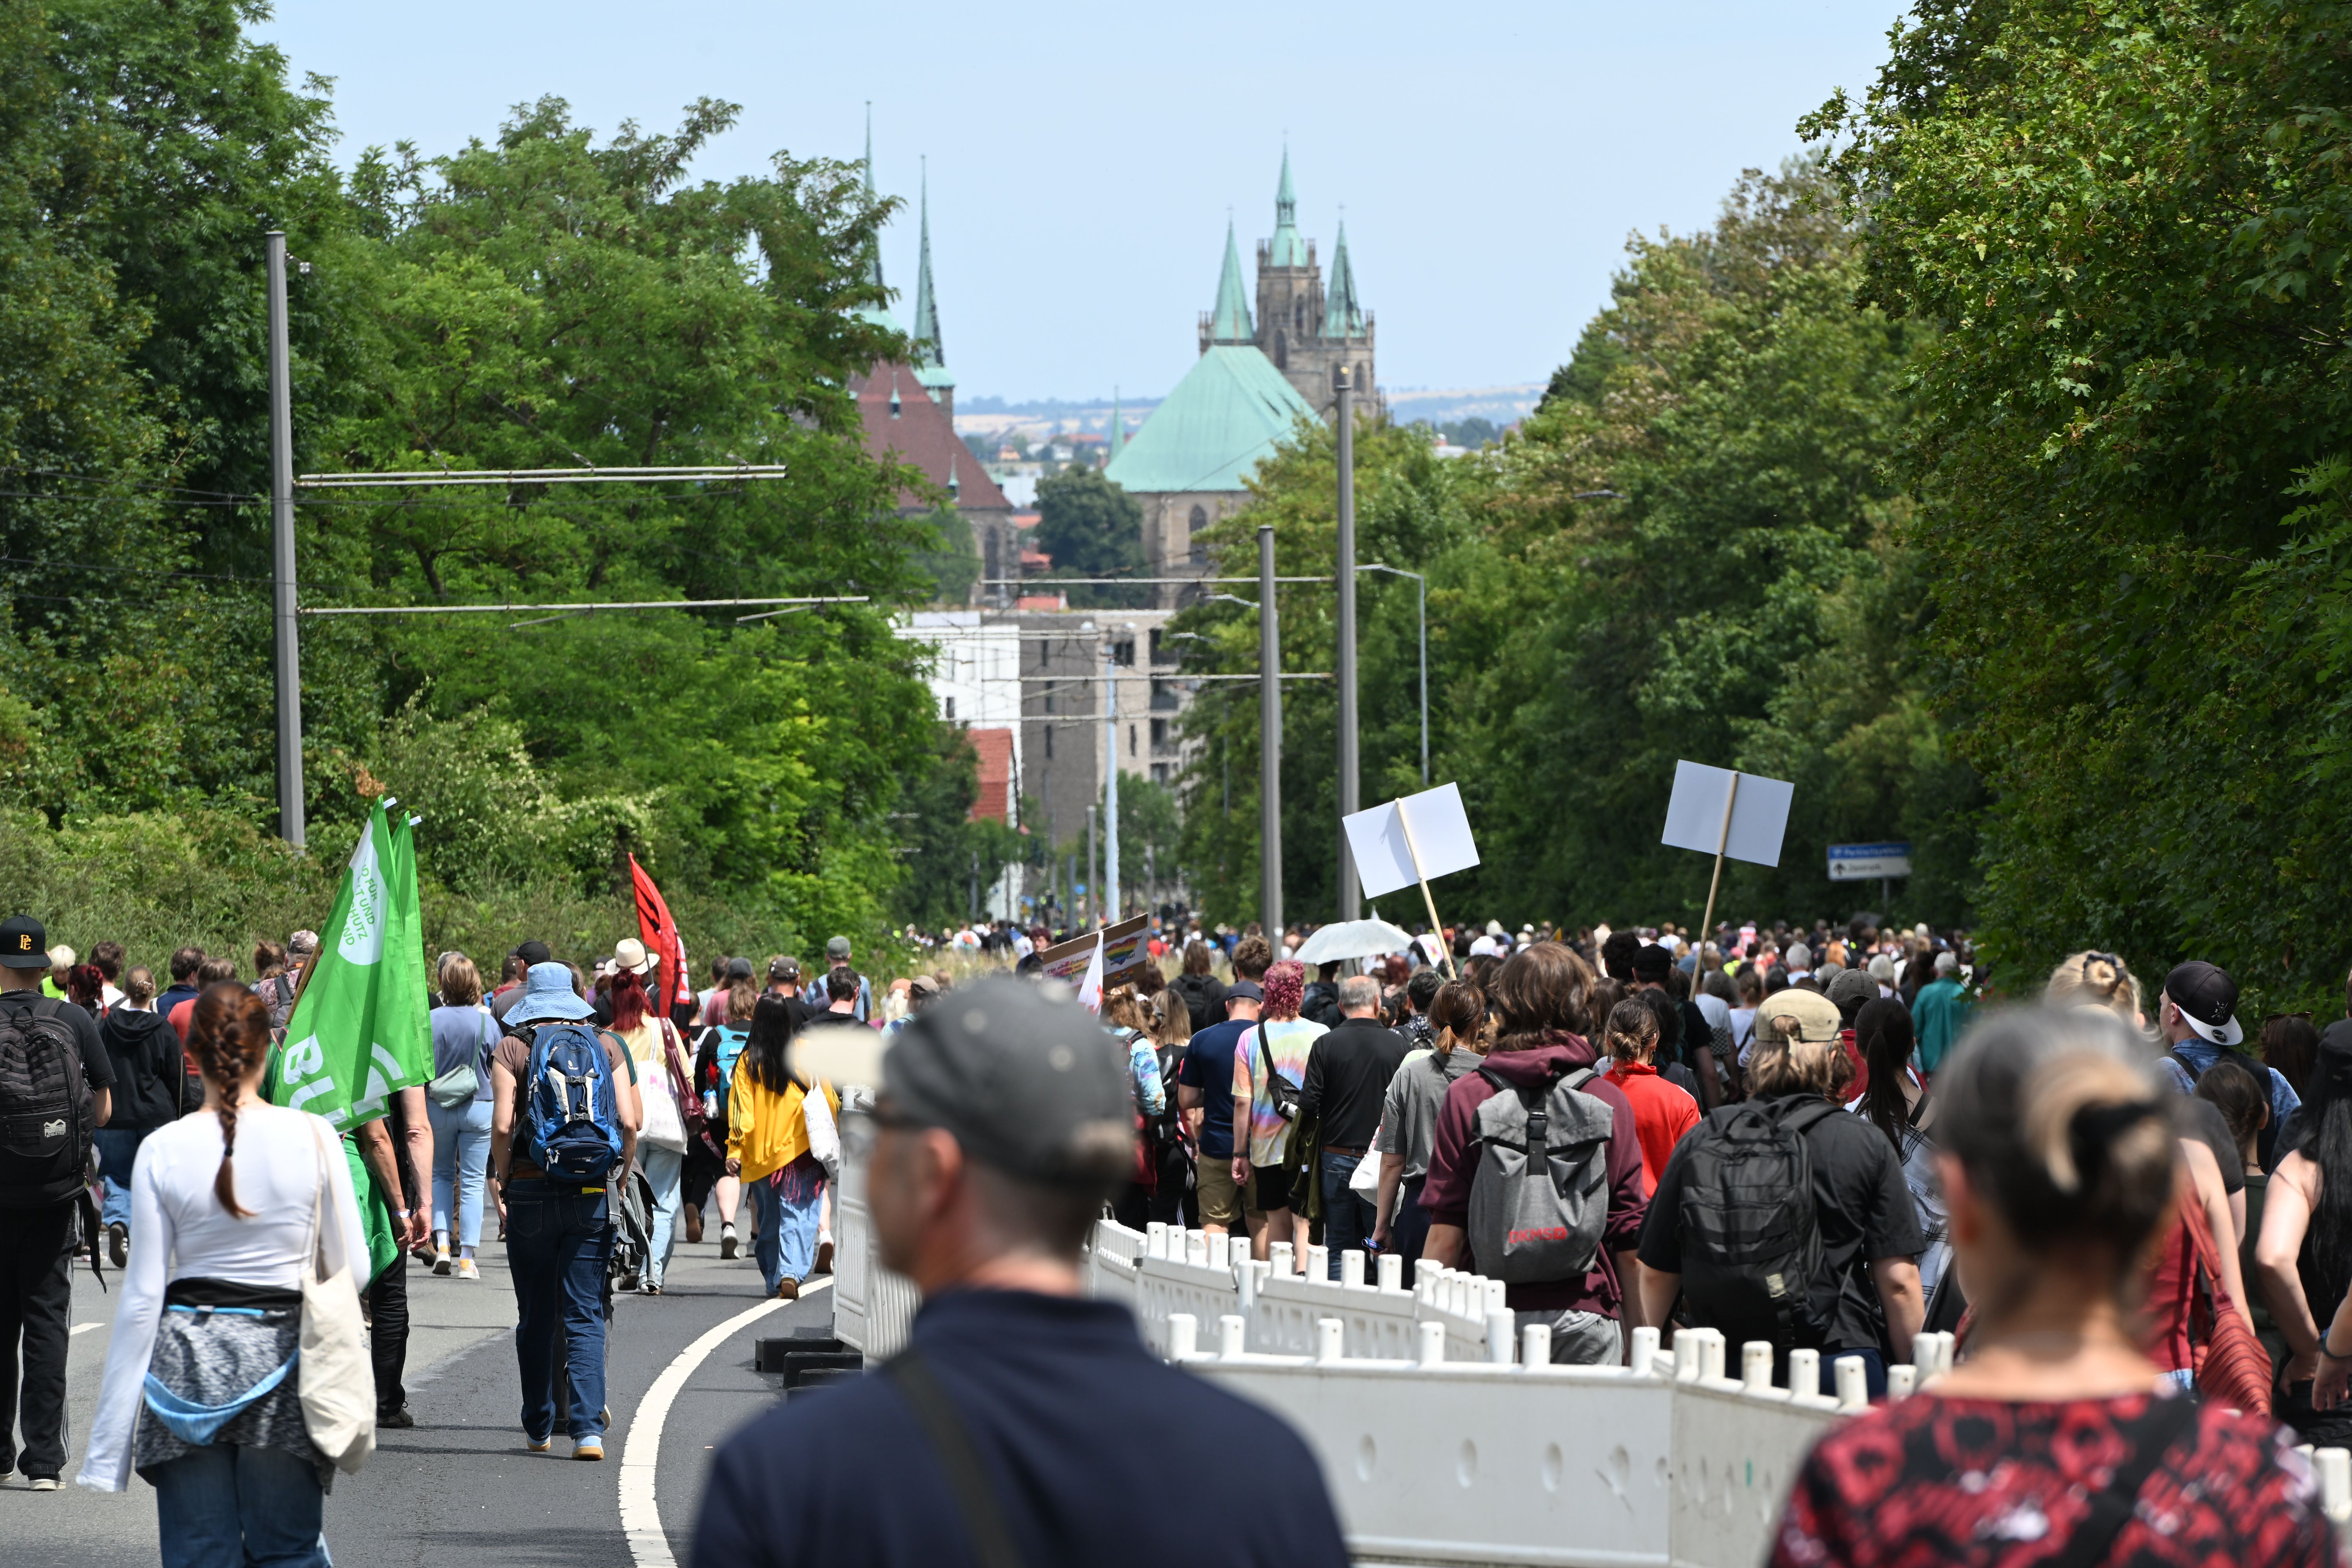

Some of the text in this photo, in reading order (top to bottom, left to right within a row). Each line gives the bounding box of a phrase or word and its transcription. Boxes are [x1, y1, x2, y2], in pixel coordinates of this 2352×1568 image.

[364, 878, 378, 902] FÜR
[359, 898, 375, 925] UND
[284, 1030, 353, 1135] BU
[44, 1125, 66, 1137] PHANTOM
[1509, 1227, 1553, 1244] DKMS
